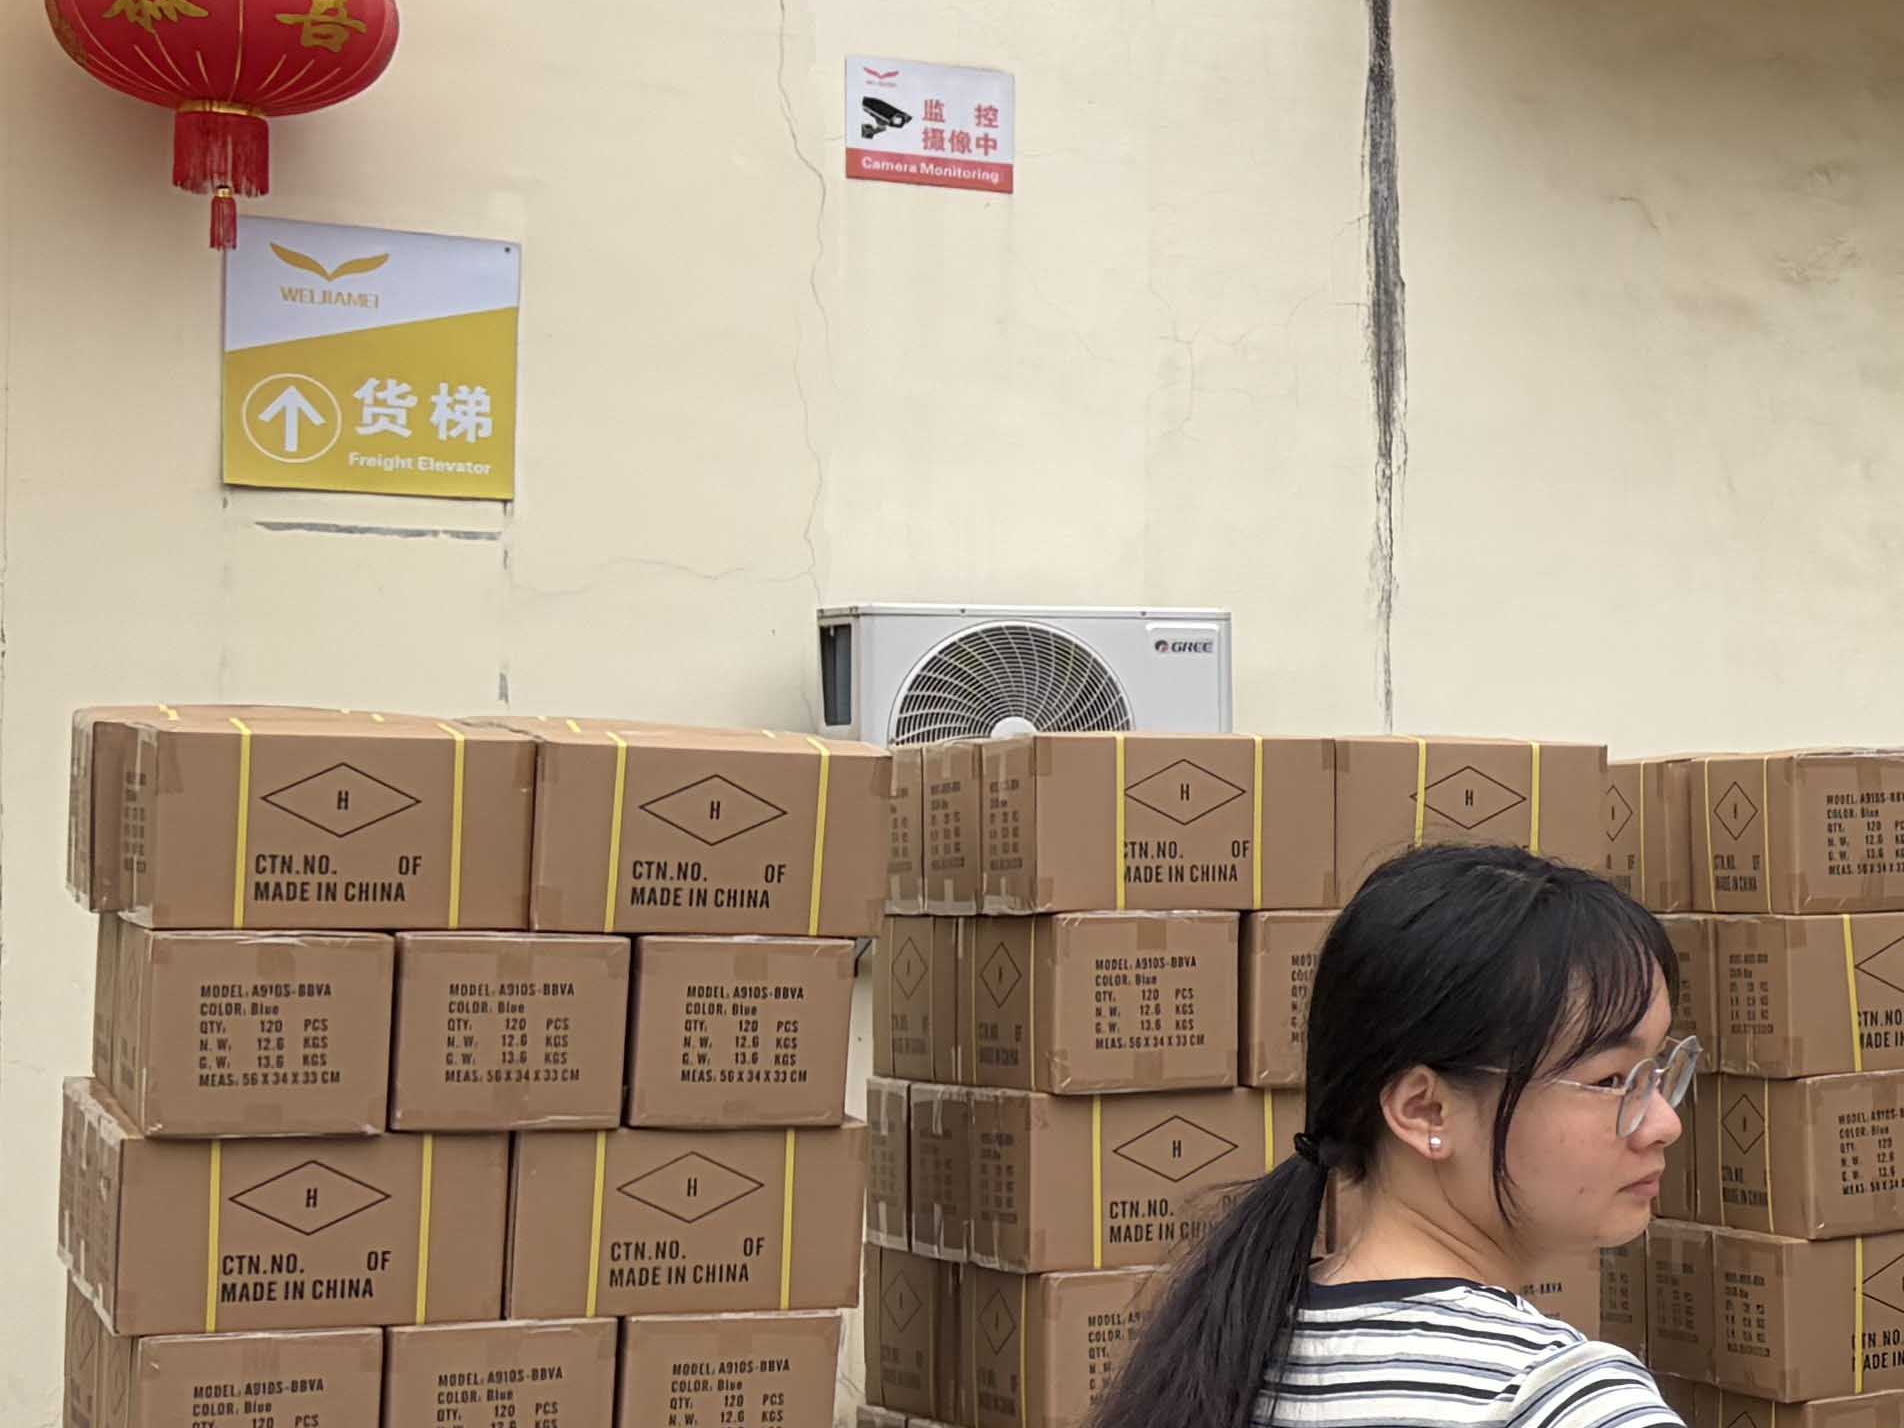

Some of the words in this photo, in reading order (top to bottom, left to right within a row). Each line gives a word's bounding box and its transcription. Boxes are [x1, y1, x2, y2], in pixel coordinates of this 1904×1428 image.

[861, 156, 918, 173] Camera
[920, 162, 1000, 185] Monitoring
[280, 286, 379, 309] WEIJIAMEI
[353, 377, 493, 444] 货梯
[349, 451, 414, 472] Freight
[418, 453, 492, 476] Elevator
[1171, 639, 1214, 654] GREE
[337, 790, 348, 810] H
[1181, 784, 1189, 801] H
[710, 801, 720, 820] H
[1232, 840, 1250, 858] OF
[255, 854, 337, 875] CTN.NO.
[399, 856, 422, 875] OF
[633, 860, 707, 882] CTN.NO.
[765, 864, 786, 883] OF
[1169, 865, 1184, 882] IN
[1190, 864, 1237, 882] CHINA
[254, 881, 310, 901] MADE
[317, 882, 337, 901] IN
[344, 882, 405, 902] CHINA
[631, 887, 683, 906] MADE
[689, 888, 707, 907] IN
[714, 889, 769, 908] CHINA
[1173, 1140, 1181, 1158] H
[687, 1178, 697, 1196] H
[306, 1188, 317, 1208] H
[1110, 1198, 1174, 1219] CTN.NO.
[1110, 1224, 1153, 1243] MADE
[1159, 1223, 1174, 1241] IN
[611, 1240, 686, 1262] CTN.NO.
[744, 1237, 764, 1256] OF
[223, 1253, 304, 1276] CTN.NO.
[367, 1251, 391, 1271] OF
[610, 1266, 661, 1287] MADE
[668, 1266, 686, 1284] IN
[693, 1264, 748, 1284] CHINA
[221, 1281, 277, 1302] MADE
[284, 1280, 304, 1300] IN
[312, 1278, 373, 1300] CHINA
